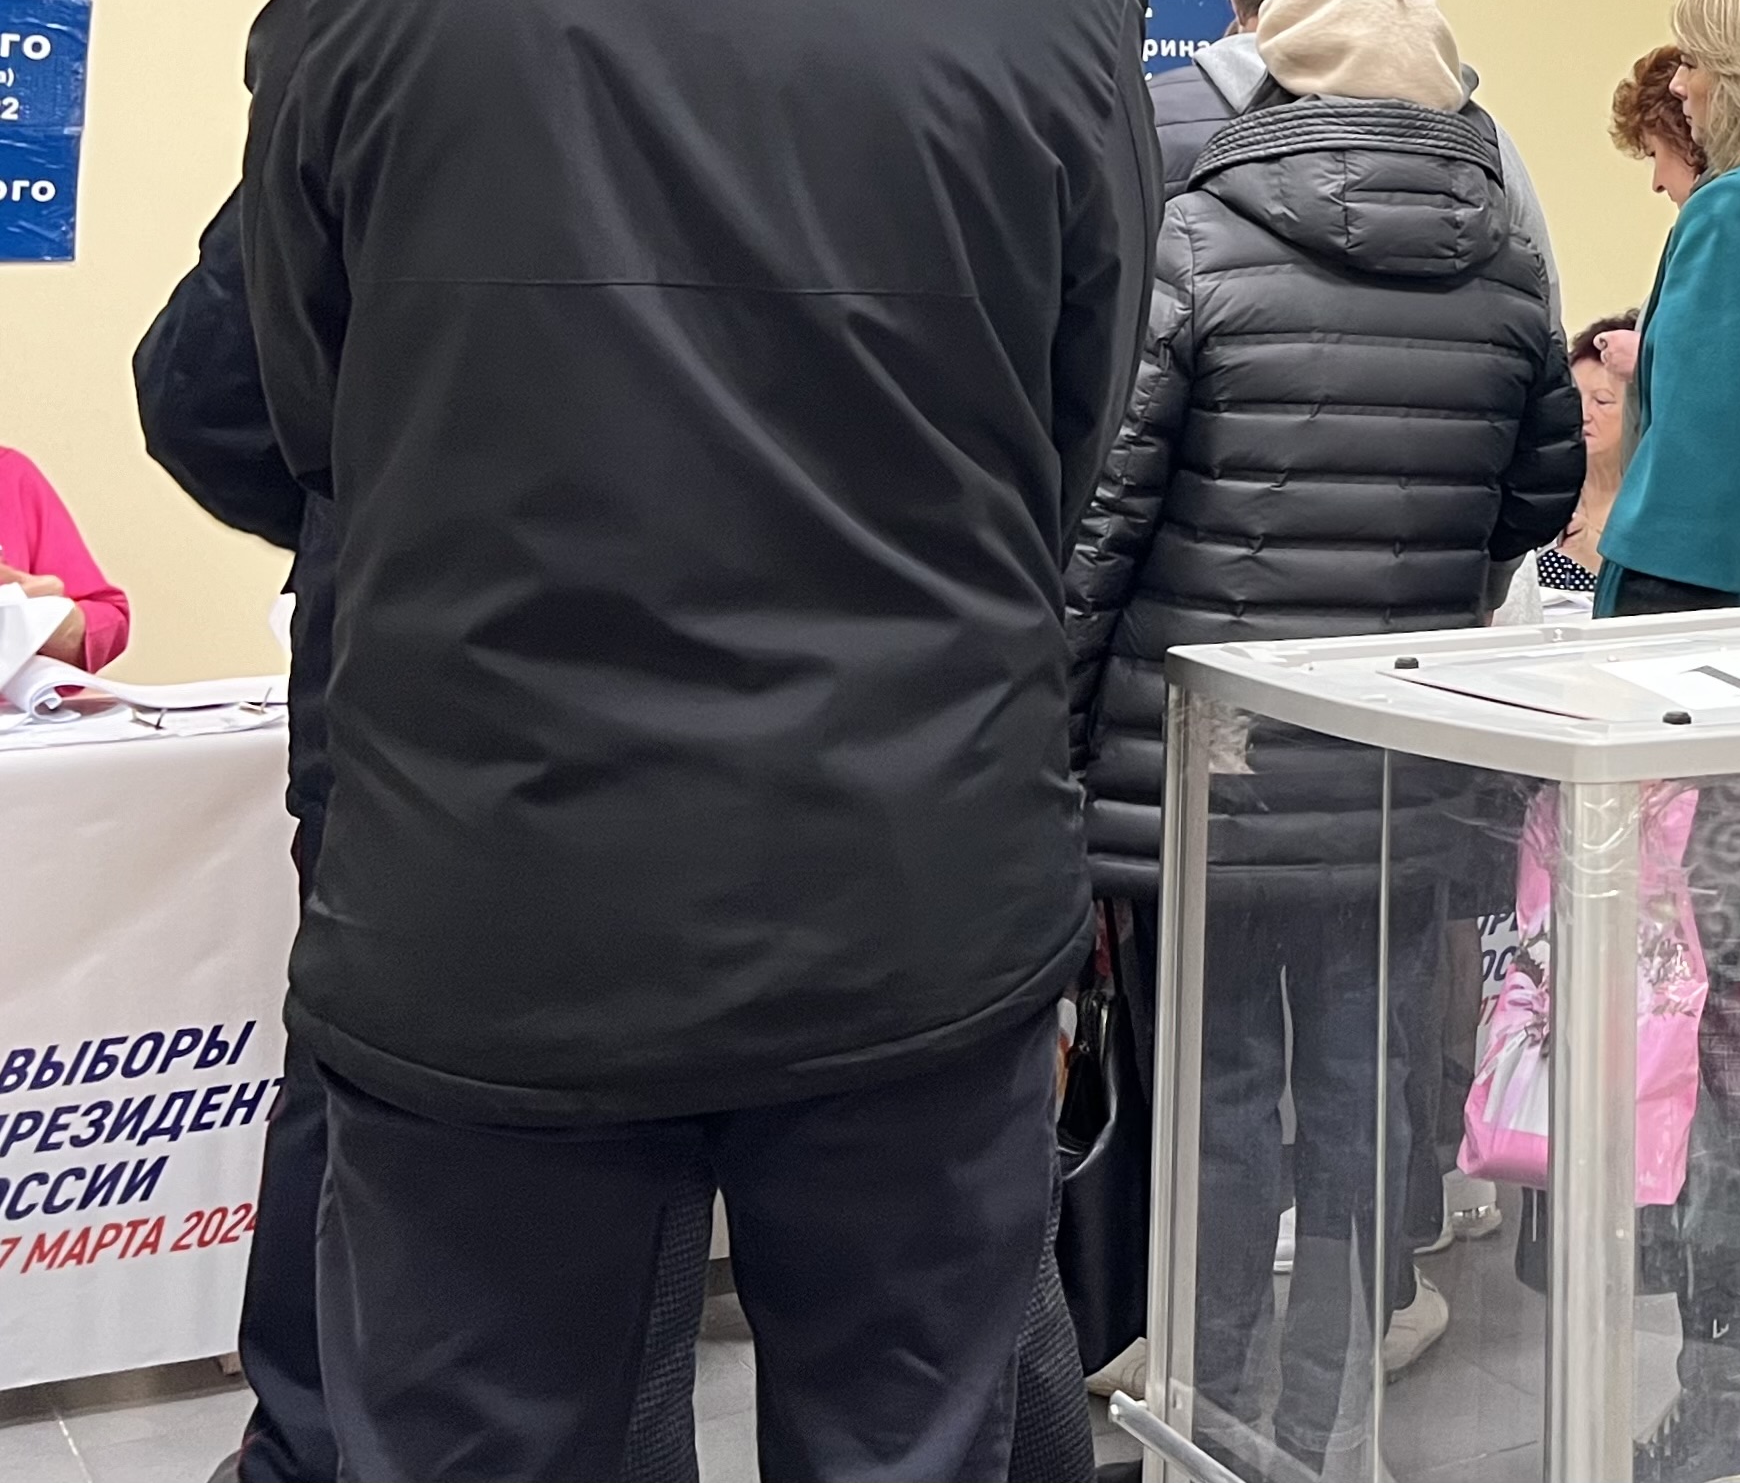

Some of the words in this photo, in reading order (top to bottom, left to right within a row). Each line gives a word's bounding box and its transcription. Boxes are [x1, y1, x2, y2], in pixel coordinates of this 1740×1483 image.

[0, 33, 51, 60] го
[0, 1020, 257, 1095] ВЫБОРЫ
[20, 1215, 166, 1274] МАРТА
